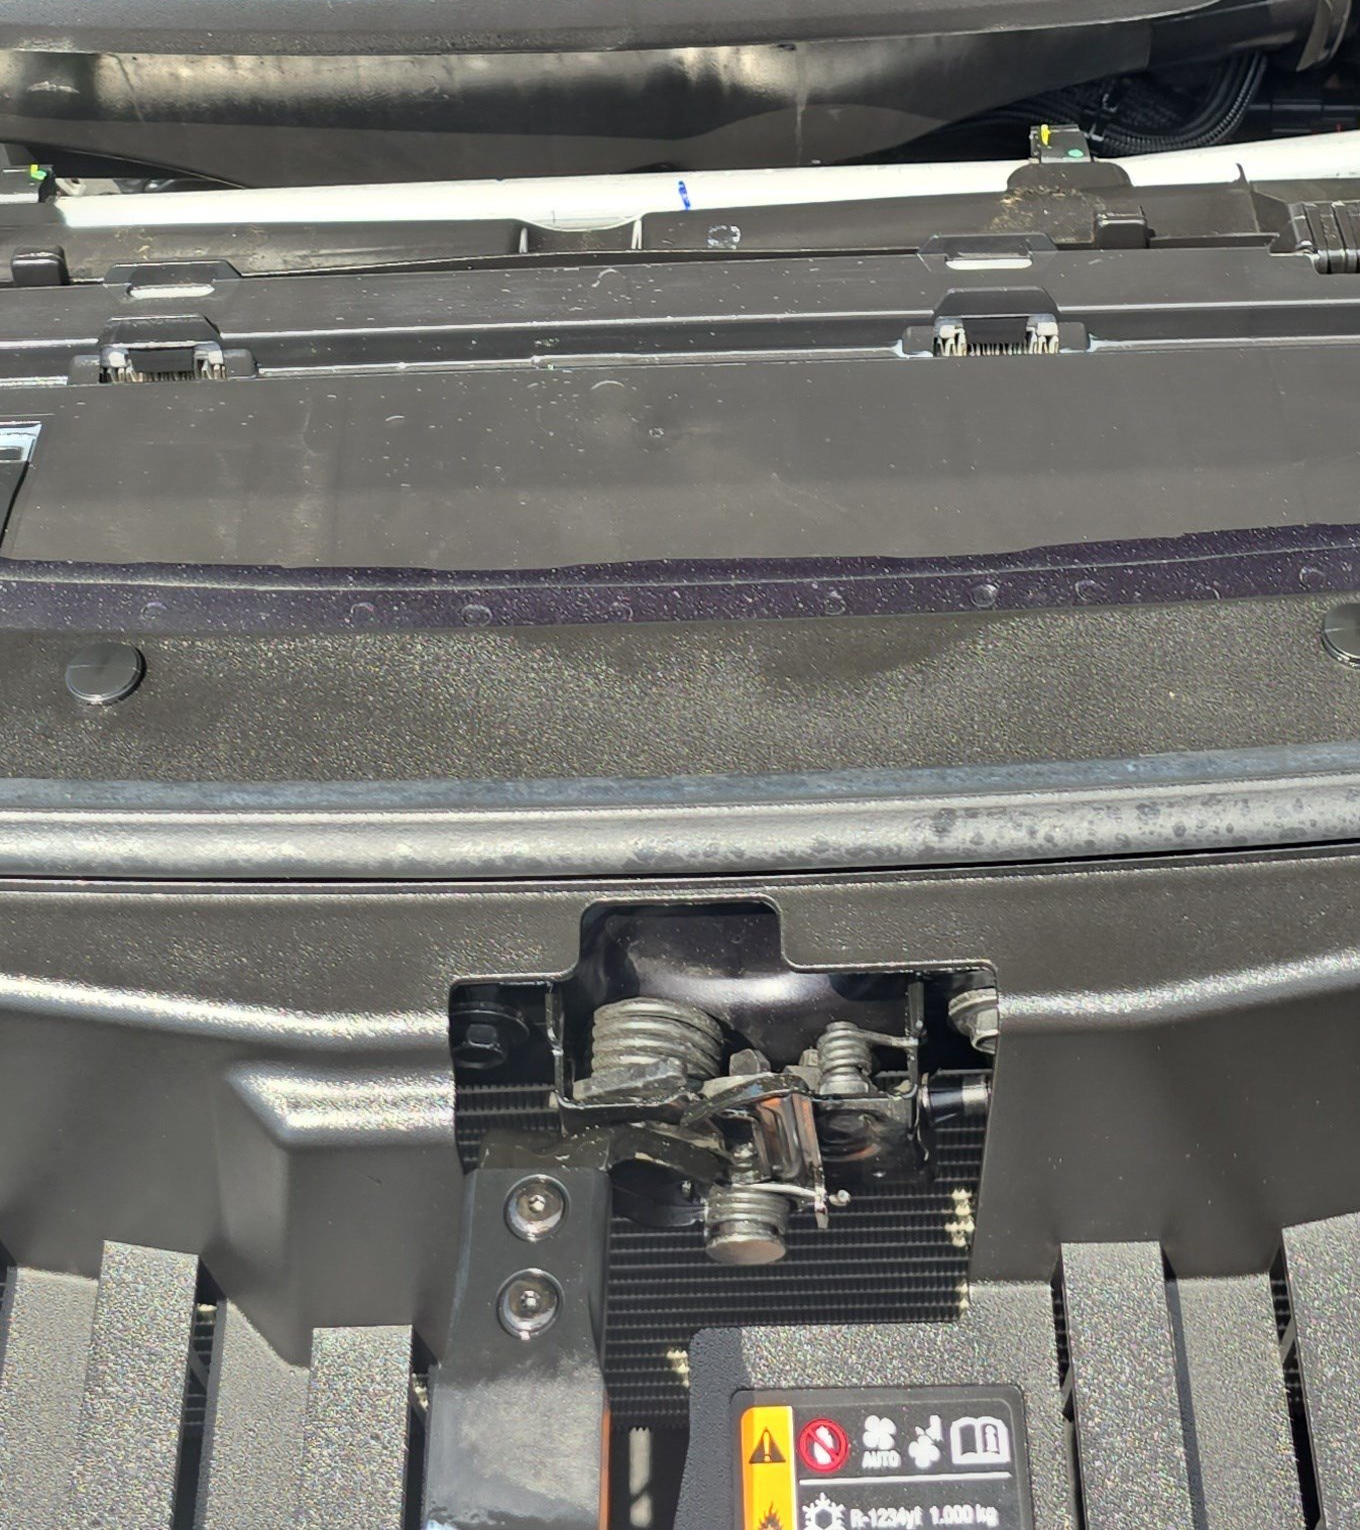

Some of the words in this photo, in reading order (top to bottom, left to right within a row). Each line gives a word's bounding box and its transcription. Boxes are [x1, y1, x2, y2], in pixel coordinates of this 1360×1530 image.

[862, 1450, 901, 1469] AUTO
[850, 1505, 923, 1529] R-1234yf
[930, 1504, 974, 1525] 1.000
